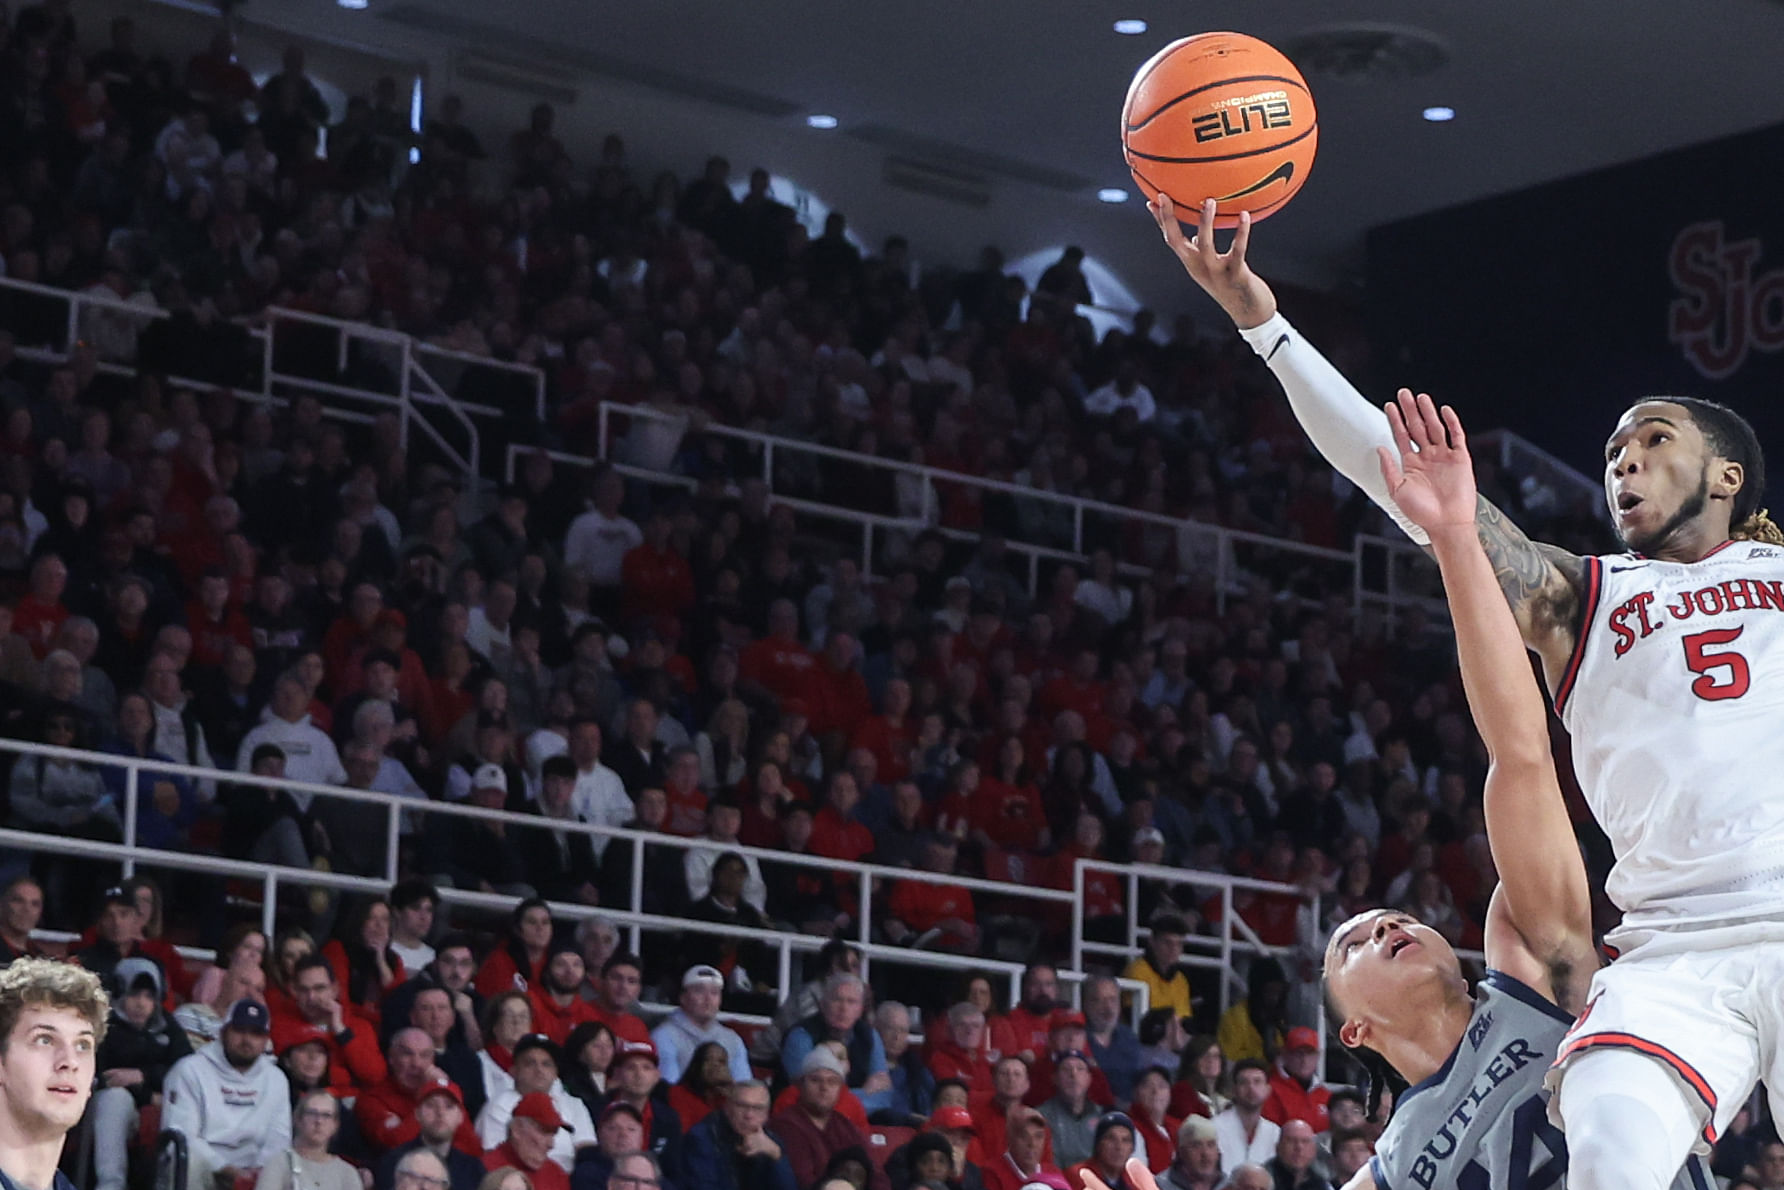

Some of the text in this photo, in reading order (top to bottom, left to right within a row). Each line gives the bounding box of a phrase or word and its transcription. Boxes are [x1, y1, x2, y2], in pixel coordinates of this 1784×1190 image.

[1191, 101, 1292, 143] ELITE
[1608, 592, 1664, 659] ST.
[1682, 624, 1750, 700] 5
